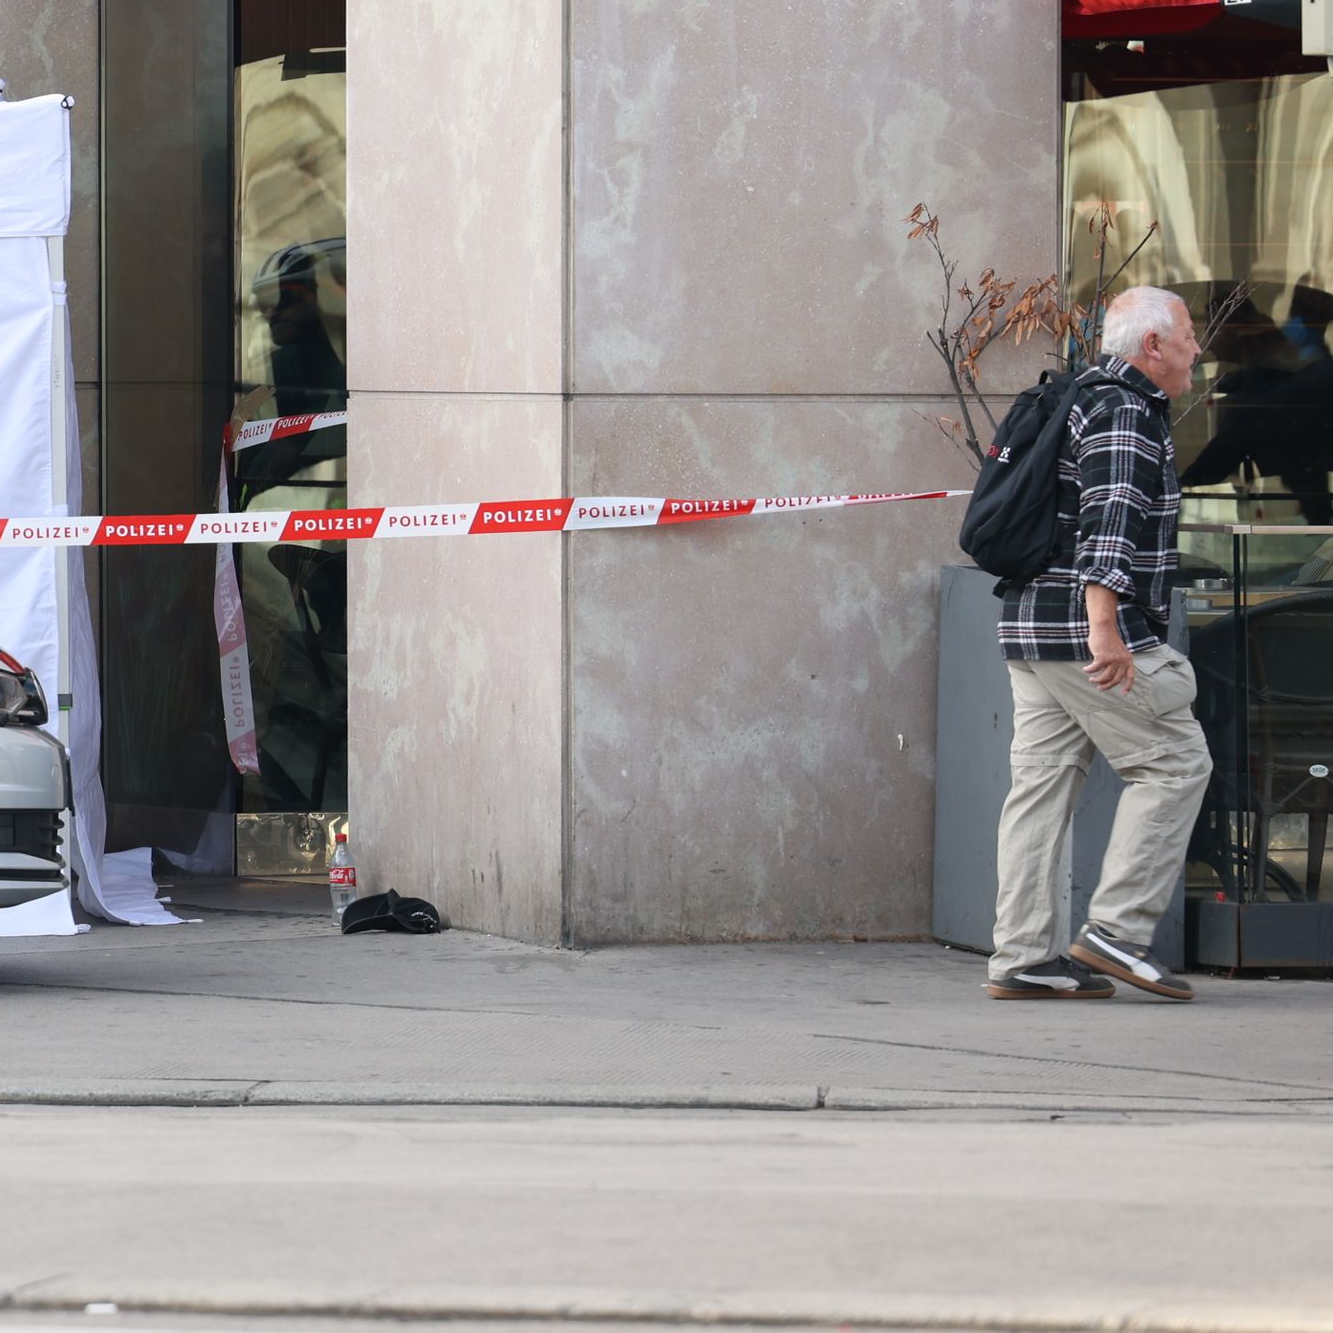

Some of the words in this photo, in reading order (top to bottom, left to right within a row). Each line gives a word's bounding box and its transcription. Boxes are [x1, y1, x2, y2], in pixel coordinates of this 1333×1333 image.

[238, 423, 268, 441] POLIZEI
[12, 527, 79, 539] POLIZEI
[105, 524, 173, 537] POLIZEI
[200, 523, 268, 534] POLIZEI
[294, 518, 362, 531] POLIZEI
[389, 514, 456, 527] POLIZEI
[483, 508, 551, 524] POLIZEI
[579, 504, 645, 519] POLIZEI
[671, 499, 738, 514] POLIZEI
